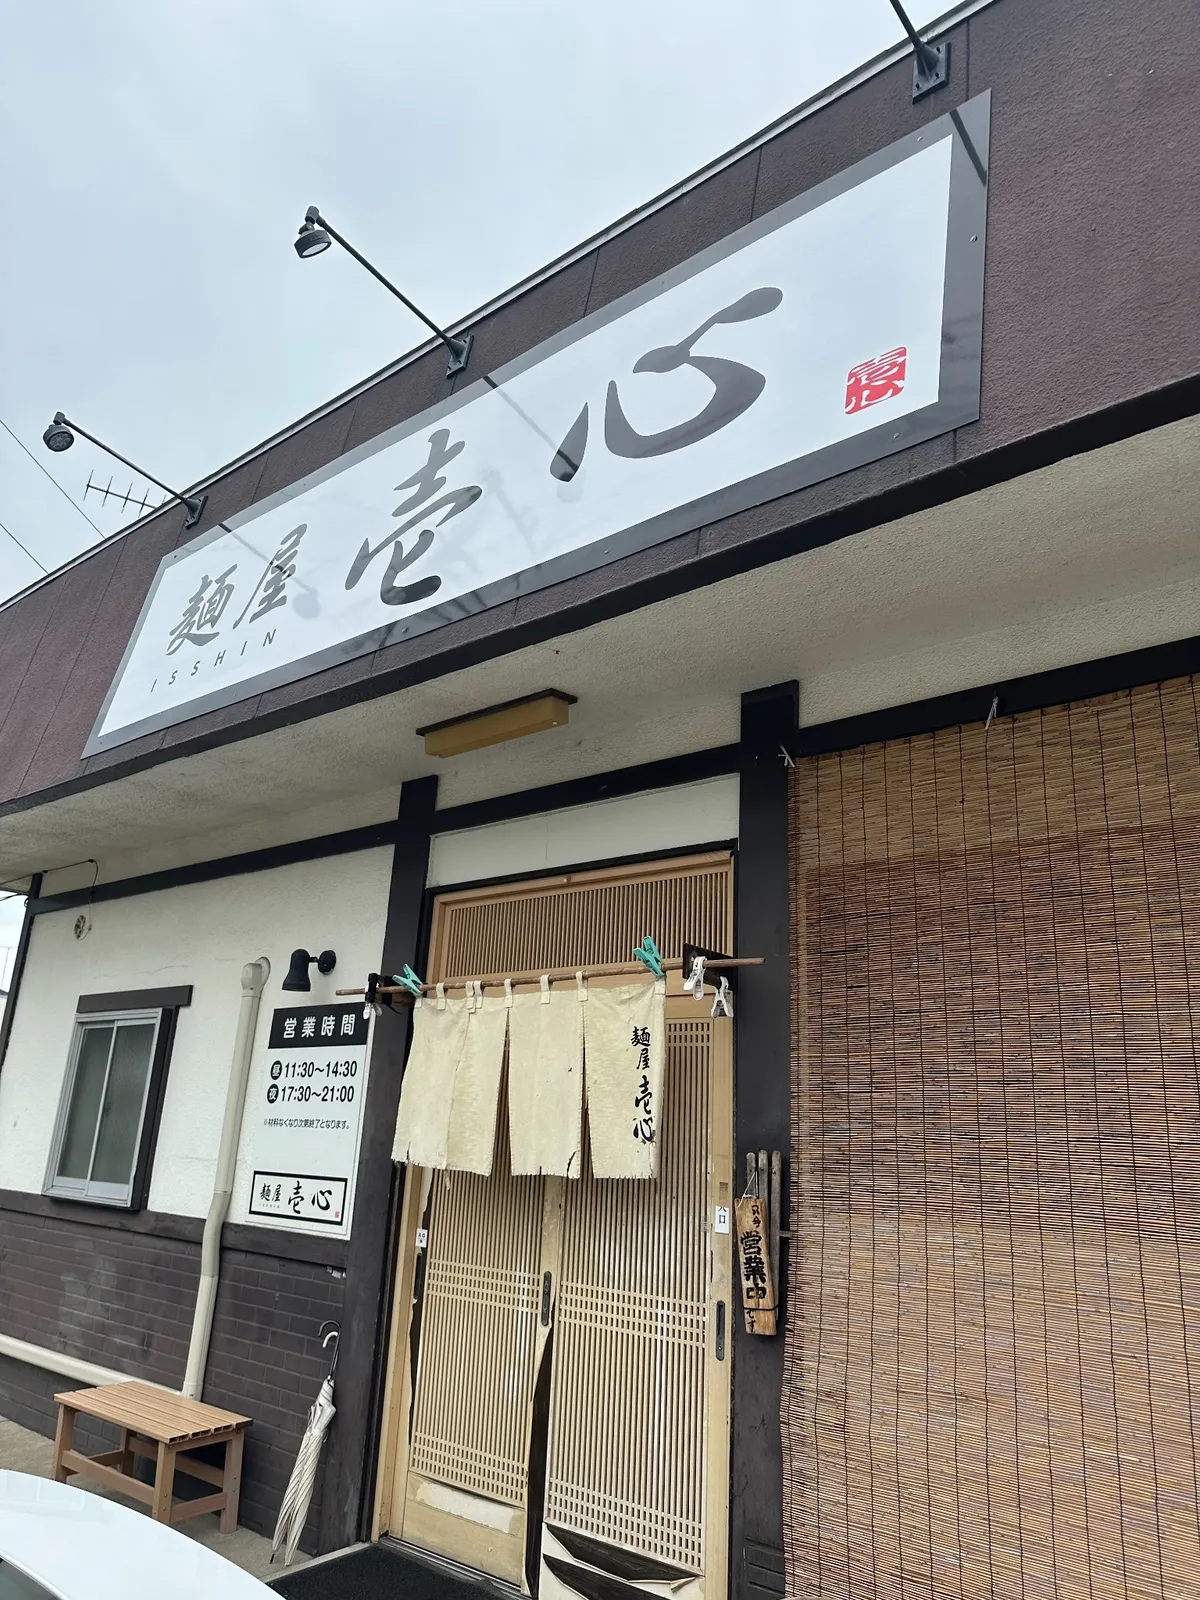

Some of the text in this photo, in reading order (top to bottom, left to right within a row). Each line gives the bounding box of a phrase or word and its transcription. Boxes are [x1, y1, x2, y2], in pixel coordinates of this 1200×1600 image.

[150, 629, 277, 692] ISSHIN
[283, 1014, 356, 1039] 営業時間
